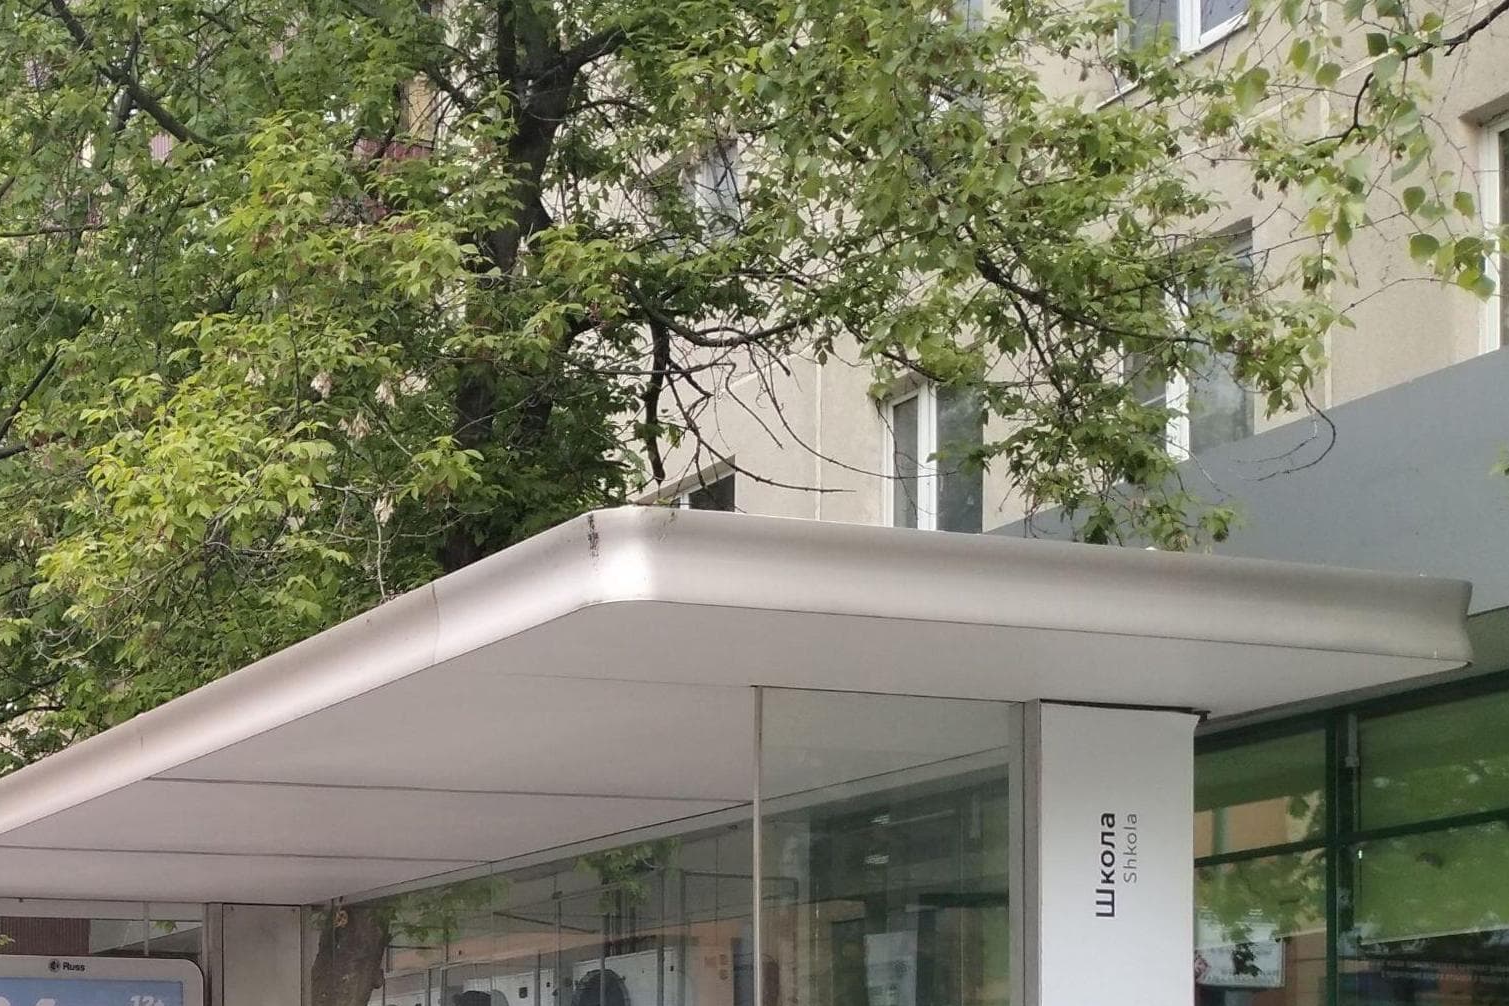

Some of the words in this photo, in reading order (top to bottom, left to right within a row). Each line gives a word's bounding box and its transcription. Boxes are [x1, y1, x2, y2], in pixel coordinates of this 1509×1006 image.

[1095, 812, 1115, 917] Школа
[1123, 813, 1137, 883] Shkola
[62, 961, 85, 971] Russ
